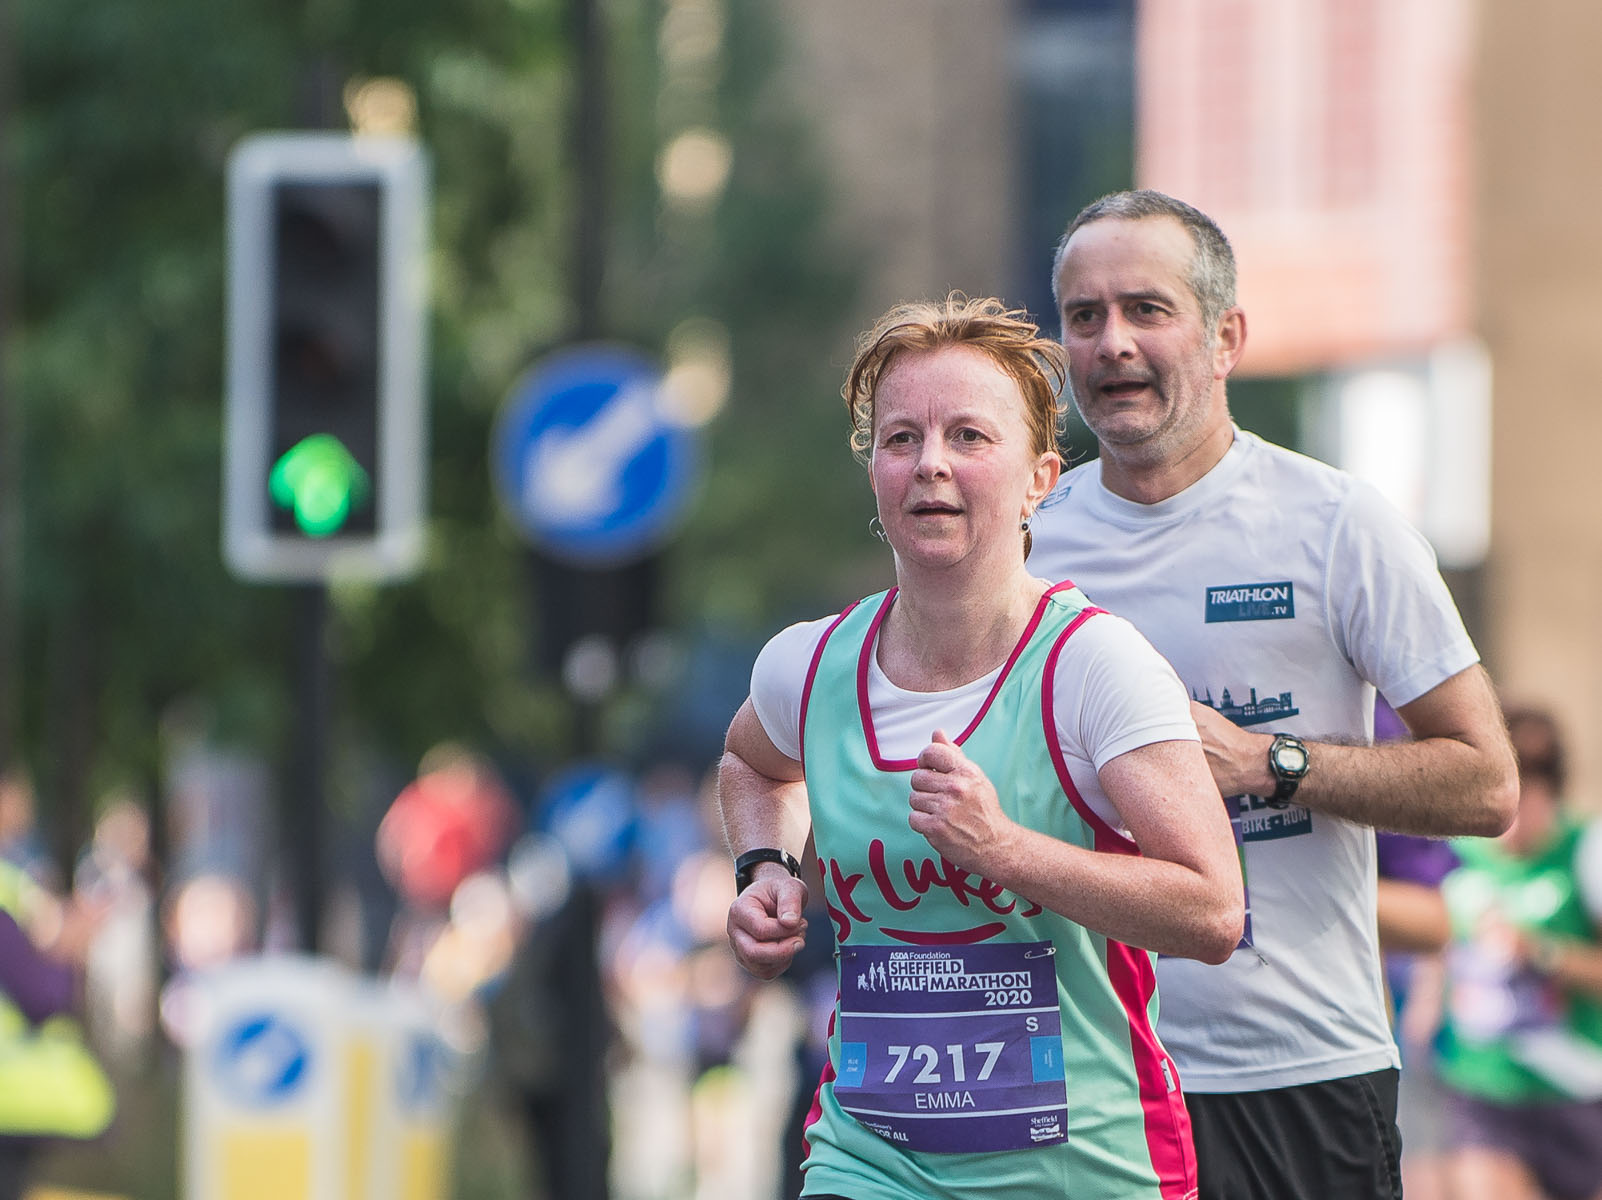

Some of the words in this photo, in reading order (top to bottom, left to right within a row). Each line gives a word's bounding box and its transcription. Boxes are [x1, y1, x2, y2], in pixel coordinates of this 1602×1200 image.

[1210, 586, 1288, 604] TRIATHLON
[1242, 817, 1272, 834] BIKE
[1282, 807, 1308, 826] RUN
[890, 952, 909, 960] ASDA
[909, 952, 950, 960] Foundation
[890, 961, 961, 975] SHEFFIELD
[891, 977, 927, 991] HALF
[930, 973, 1029, 990] MARATHON
[984, 989, 1032, 1006] 2020
[1026, 1017, 1039, 1031] S
[884, 1041, 1005, 1083] 7217
[915, 1091, 975, 1109] EMMA
[893, 1131, 909, 1141] ALL
